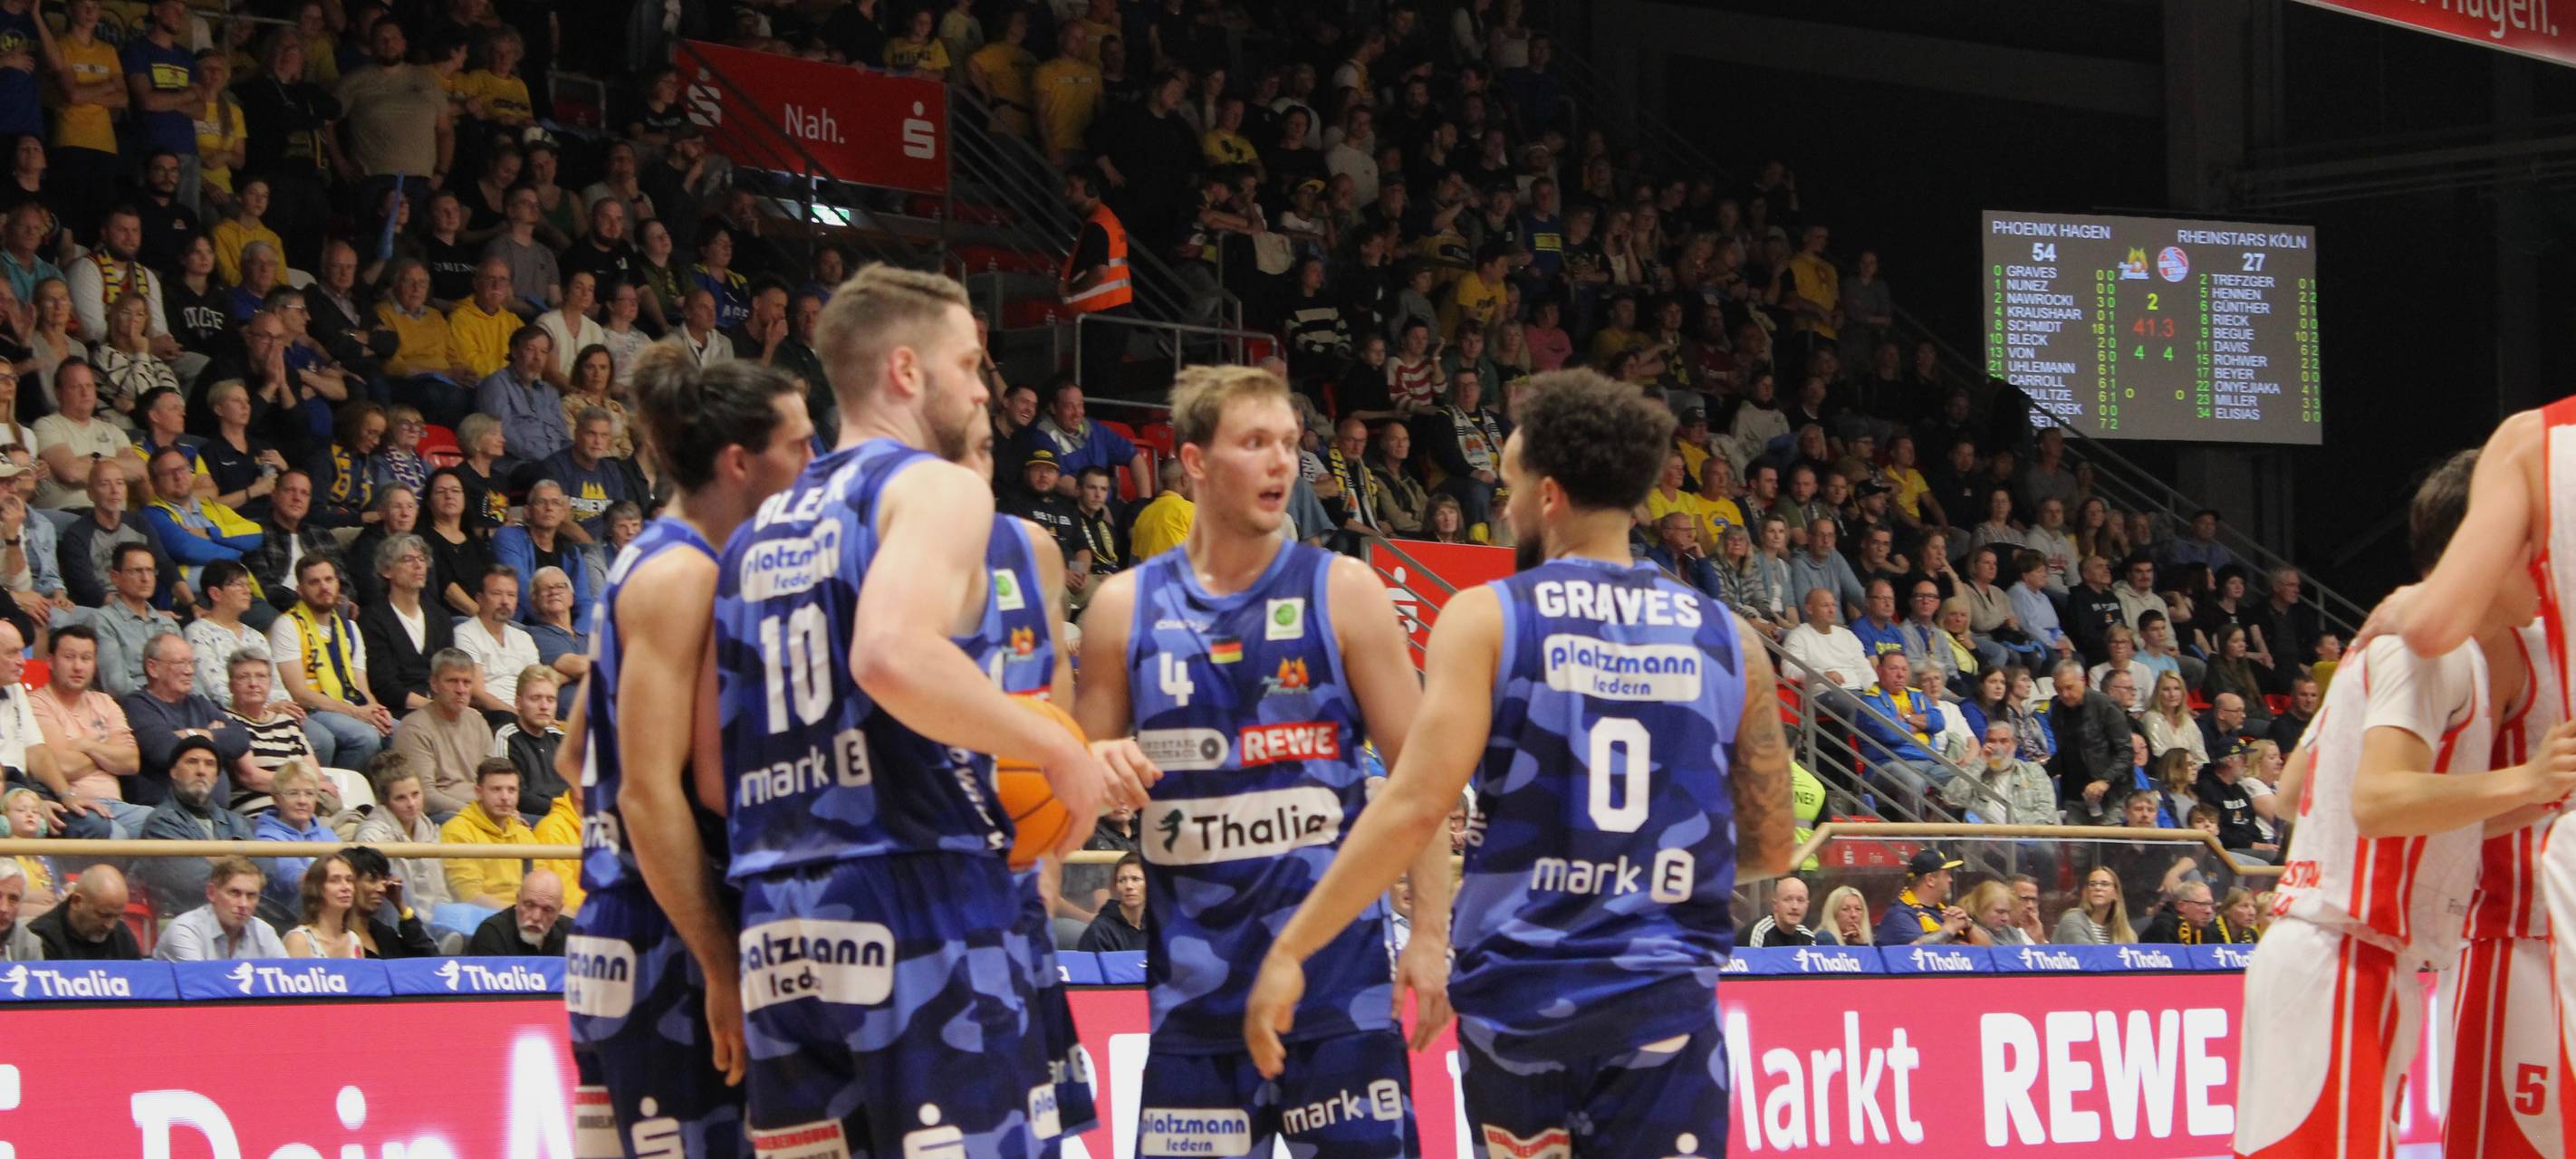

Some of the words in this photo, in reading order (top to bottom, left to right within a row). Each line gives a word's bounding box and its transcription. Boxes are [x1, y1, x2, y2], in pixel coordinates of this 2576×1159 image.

[2442, 0, 2559, 39] agen.
[784, 102, 845, 144] Nah.
[1992, 221, 2057, 236] PHOENIX
[2060, 224, 2110, 239] HAGEN
[2177, 230, 2266, 246] RHEINSTARS
[2269, 232, 2308, 249] KÖLN
[2032, 243, 2057, 262] 54
[2242, 252, 2265, 272] 27
[2006, 265, 2057, 279] GRAVES
[2199, 273, 2208, 285] 2
[2211, 273, 2275, 288] TREFZGER
[2007, 280, 2049, 292] NUNEZ
[2212, 288, 2262, 301] HENNEN
[1994, 292, 2003, 303] 2
[2007, 293, 2073, 306] NAWROCKI
[2096, 297, 2105, 308] 3
[2147, 292, 2159, 311] 2
[2212, 300, 2271, 314] GÜNTHER
[1994, 306, 2004, 317] 4
[2007, 306, 2082, 321] KRAUSHAAR
[2212, 315, 2250, 326] RIECK
[2007, 321, 2063, 333] SCHMIDT
[2133, 318, 2174, 338] 41.3
[2213, 328, 2254, 340] BEGUE
[1989, 333, 2004, 344] 10
[2007, 333, 2048, 346] BLECK
[2214, 340, 2250, 353] DAVIS
[1989, 347, 2004, 359] 13
[2007, 348, 2035, 359] VON
[2134, 345, 2145, 359] 4
[2163, 346, 2174, 361] 4
[2196, 354, 2210, 365] 15
[2214, 355, 2268, 368] ROHWER
[2007, 360, 2076, 374] UHLEMANN
[2214, 368, 2254, 380] BEYER
[2007, 374, 2066, 388] CARROLL
[2196, 380, 2210, 392] 22
[2196, 395, 2210, 406] 23
[2216, 395, 2258, 407] MILLER
[2196, 407, 2211, 418] 34
[2216, 407, 2261, 420] ELISIAS
[1535, 580, 1702, 627] GRAVES
[1552, 641, 1697, 675] platzmann
[760, 602, 832, 734] 10
[1159, 652, 1194, 706] 4
[1594, 679, 1652, 695] ledern
[1244, 726, 1334, 761] REWE
[741, 745, 829, 807] mark
[1589, 716, 1651, 833] 0
[1192, 805, 1326, 850] Thalia
[1532, 856, 1641, 895] mark
[1809, 952, 1862, 972] Thalia
[1925, 951, 1974, 971] Thalia
[2033, 951, 2080, 970] Thalia
[2129, 950, 2173, 968] Thalia
[33, 969, 130, 997] Thalia
[257, 967, 348, 994] Thalia
[462, 964, 546, 991] Thalia
[1981, 1009, 2235, 1147] REWE
[2514, 1062, 2549, 1116] 5
[1282, 1089, 1364, 1135] mark
[1166, 1137, 1213, 1151] ledern
